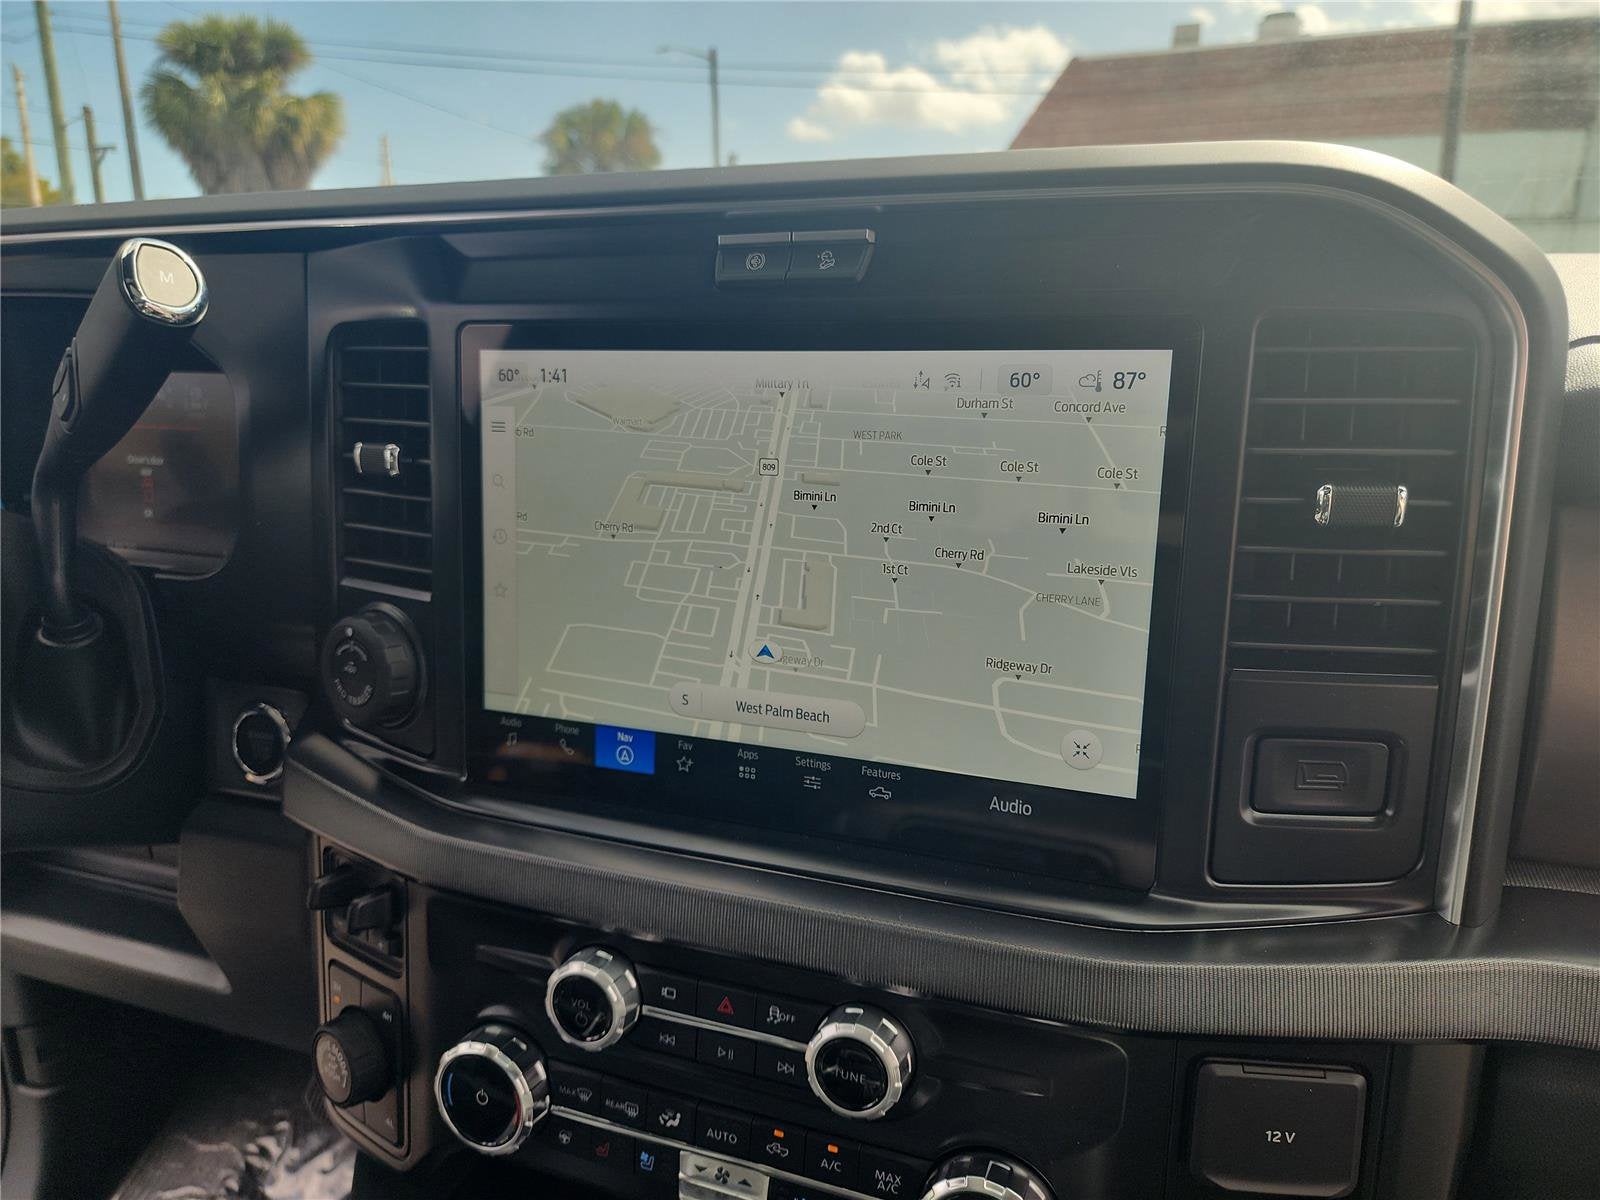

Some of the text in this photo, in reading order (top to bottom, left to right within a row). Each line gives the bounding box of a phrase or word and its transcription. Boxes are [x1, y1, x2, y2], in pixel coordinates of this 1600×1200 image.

[160, 270, 174, 284] M
[498, 368, 520, 382] 60°
[540, 368, 567, 383] 1:41
[1009, 371, 1041, 389] 60°
[1112, 371, 1147, 390] 87°
[956, 397, 1014, 410] Durham St
[1054, 401, 1126, 414] Concord Ave
[853, 430, 902, 441] WEST PARK
[910, 454, 947, 467] Cole St
[1000, 460, 1039, 474] Cole St
[1097, 467, 1138, 480] Cole St
[793, 490, 836, 502] Bimini Ln
[908, 501, 956, 514] Bimini Ln
[1038, 512, 1089, 526] Bimini Ln
[594, 520, 634, 534] Cherry Rd
[871, 522, 903, 535] 2nd Ct
[934, 547, 985, 562] Cherry Rd
[882, 563, 908, 577] 1st Ct
[1067, 563, 1117, 577] Lakeside
[1035, 592, 1101, 607] CHERRY LANE
[813, 657, 824, 668] Dr
[986, 657, 1053, 675] Ridgeway Dr
[681, 693, 689, 706] S
[736, 700, 830, 723] West Palm Beach
[555, 723, 579, 735] Phone
[617, 731, 633, 743] Nav
[678, 739, 693, 751] Fav
[737, 748, 759, 761] Apps
[795, 755, 832, 771] Settings
[861, 765, 901, 781] Features
[989, 795, 1032, 816] Audio
[571, 999, 590, 1010] VOL
[779, 1012, 795, 1023] OFF
[834, 1065, 866, 1084] TUNE
[706, 1127, 738, 1144] AUTO
[1265, 1130, 1296, 1143] 12 V
[820, 1158, 842, 1173] A/C
[874, 1169, 901, 1185] MAX
[877, 1182, 899, 1195] A/C
